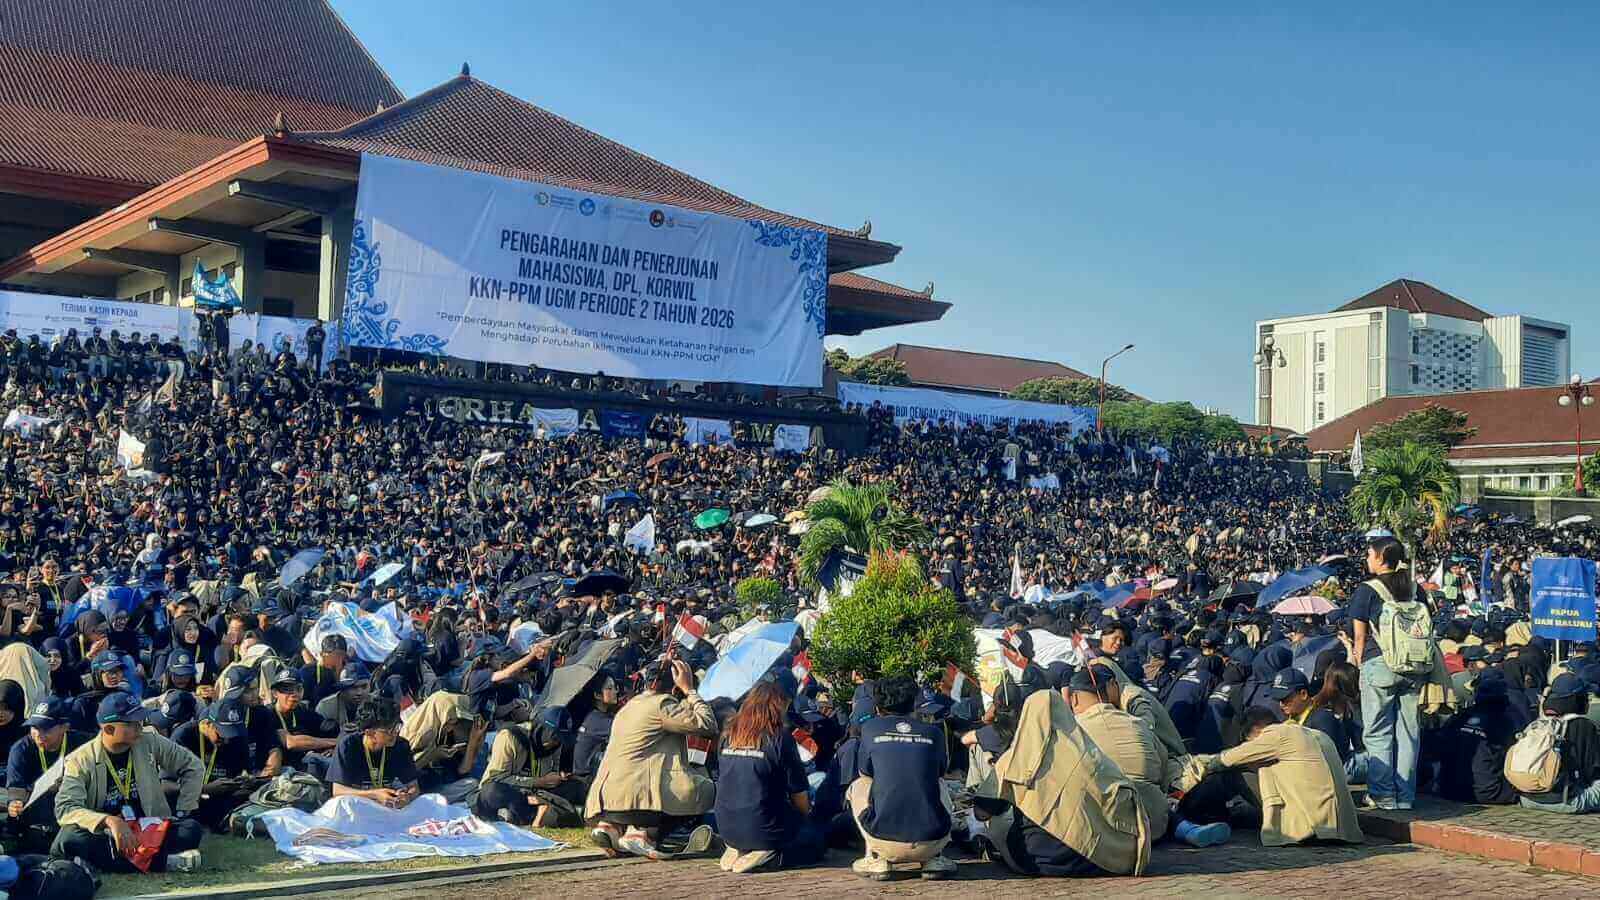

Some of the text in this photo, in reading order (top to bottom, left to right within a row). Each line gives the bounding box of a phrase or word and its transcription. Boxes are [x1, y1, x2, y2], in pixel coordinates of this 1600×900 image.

[500, 229, 719, 281] PENGARAHAN DAN PENERJUNAN
[518, 258, 697, 301] MAHASISWA, DPL, KORWIL
[469, 276, 735, 329] KKN-PPM UGM PERIODE 2 TAHUN 2026
[480, 329, 540, 345] Menghadapi
[543, 336, 591, 349] Perubahan
[651, 349, 694, 360] KKN-PPM
[571, 328, 598, 338] dalam
[658, 337, 707, 350] Ketahanan
[1551, 608, 1580, 617] PAPUA
